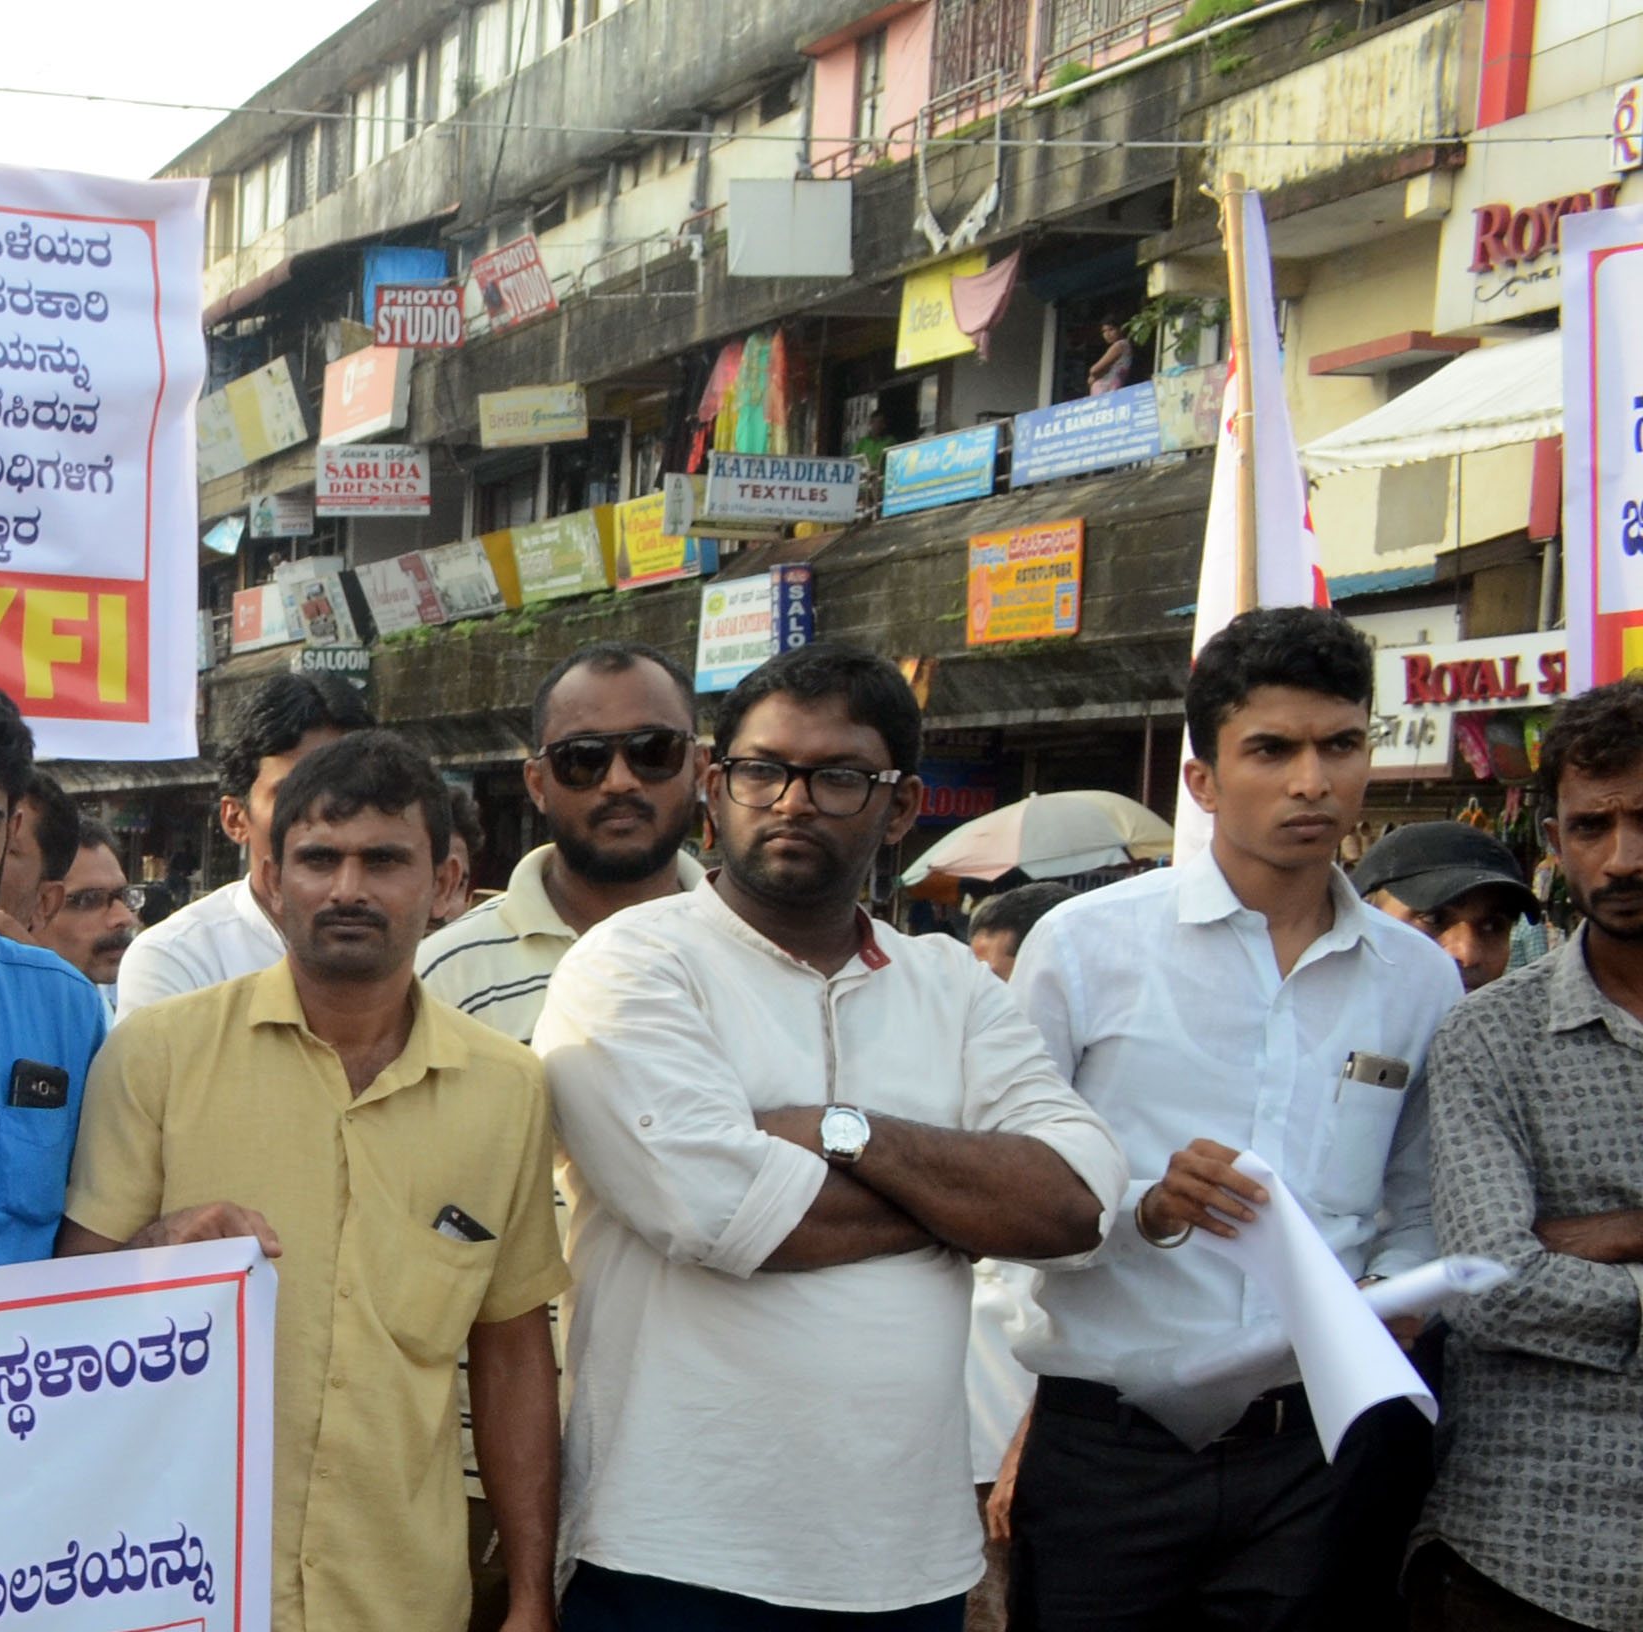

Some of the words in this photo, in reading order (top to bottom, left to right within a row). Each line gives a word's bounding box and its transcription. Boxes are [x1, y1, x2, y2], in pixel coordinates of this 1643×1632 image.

[382, 289, 458, 304] PHOTO
[498, 263, 551, 315] STUDIO
[376, 305, 461, 345] STUDIO
[1064, 407, 1115, 433] BANKERS
[324, 462, 422, 480] SABURA
[714, 456, 855, 484] KATAPADIKAR
[329, 481, 417, 494] DRESSES
[738, 484, 829, 502] TEXTILES
[1401, 653, 1531, 706] ROYAL
